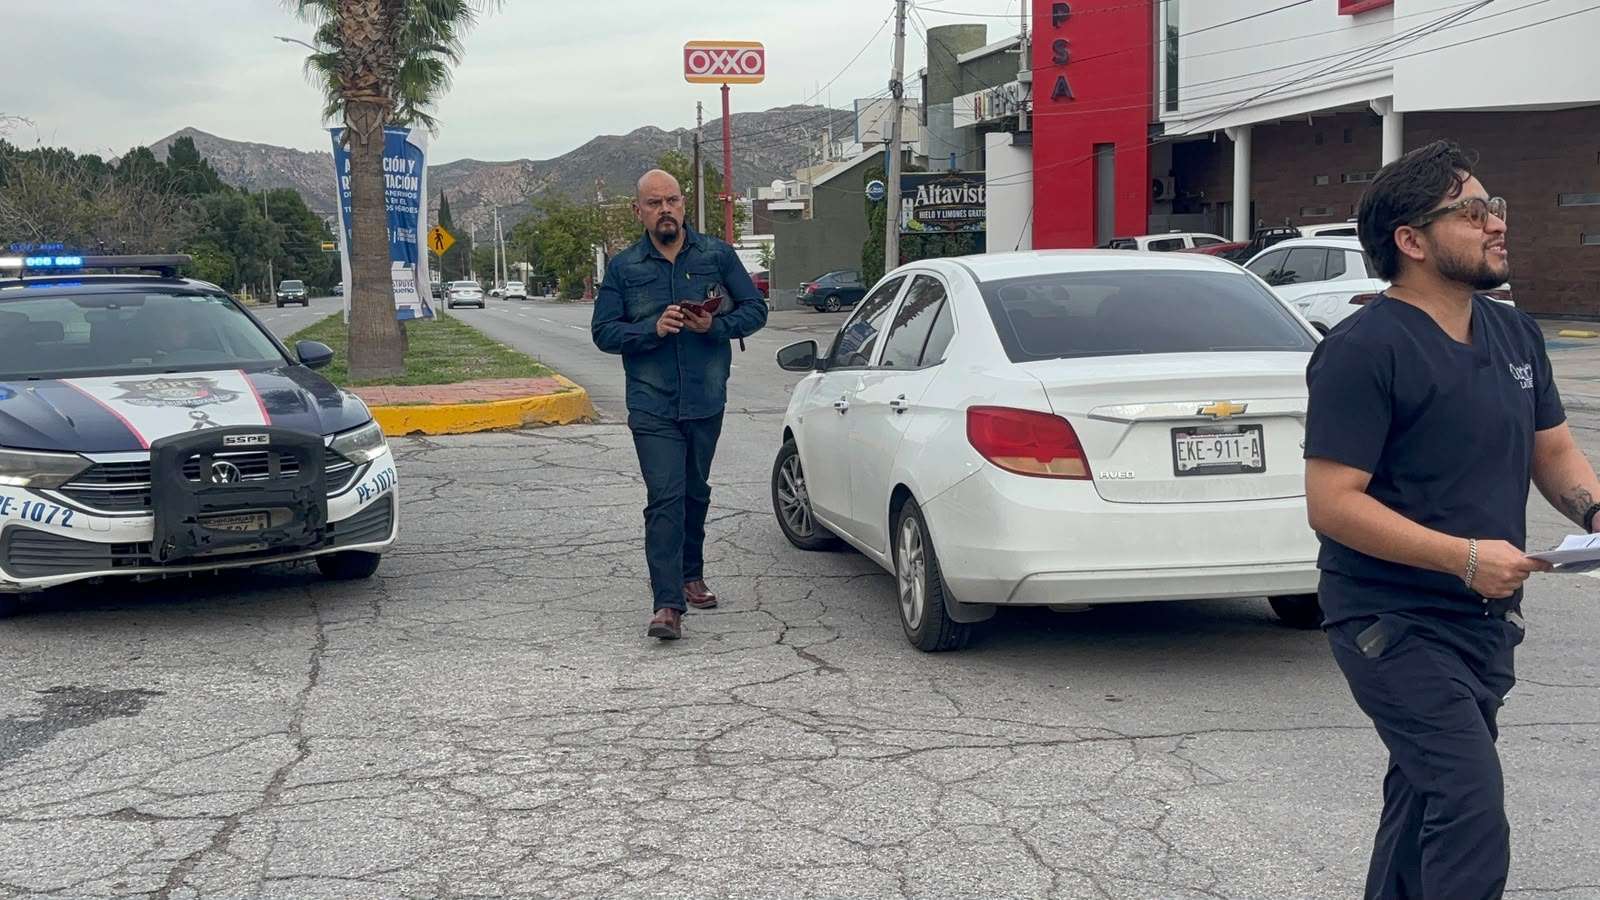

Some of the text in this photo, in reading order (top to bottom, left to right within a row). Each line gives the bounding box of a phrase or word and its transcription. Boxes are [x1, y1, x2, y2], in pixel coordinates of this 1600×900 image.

[688, 50, 762, 74] OXXO
[914, 183, 986, 206] Altavist
[225, 435, 270, 444] SSPE
[1177, 438, 1260, 461] EKE-911-A
[356, 467, 397, 504] PE-1072
